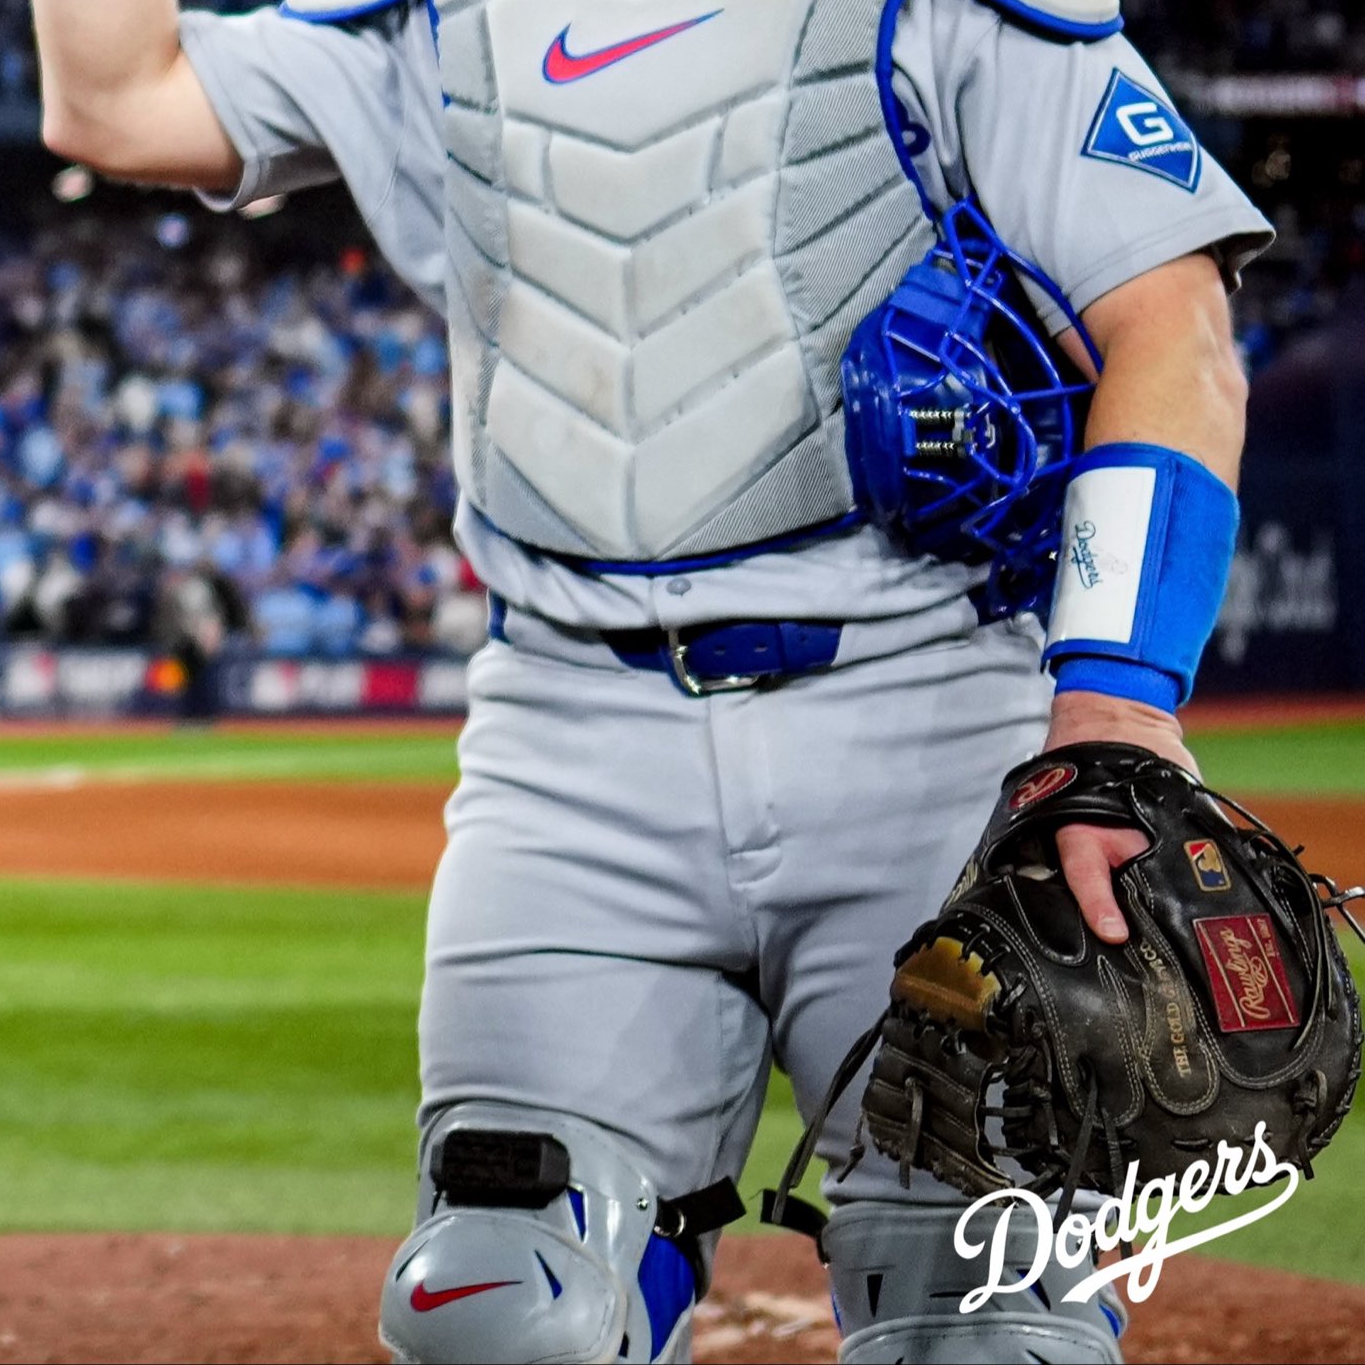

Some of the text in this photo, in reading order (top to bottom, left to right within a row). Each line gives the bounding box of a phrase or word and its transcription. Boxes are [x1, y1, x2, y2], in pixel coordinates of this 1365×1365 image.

[1116, 101, 1174, 146] G
[1071, 520, 1103, 589] Dodgers
[1220, 926, 1270, 1020] Rawlings
[1166, 1001, 1185, 1044] GOLD
[1173, 1046, 1192, 1078] THE
